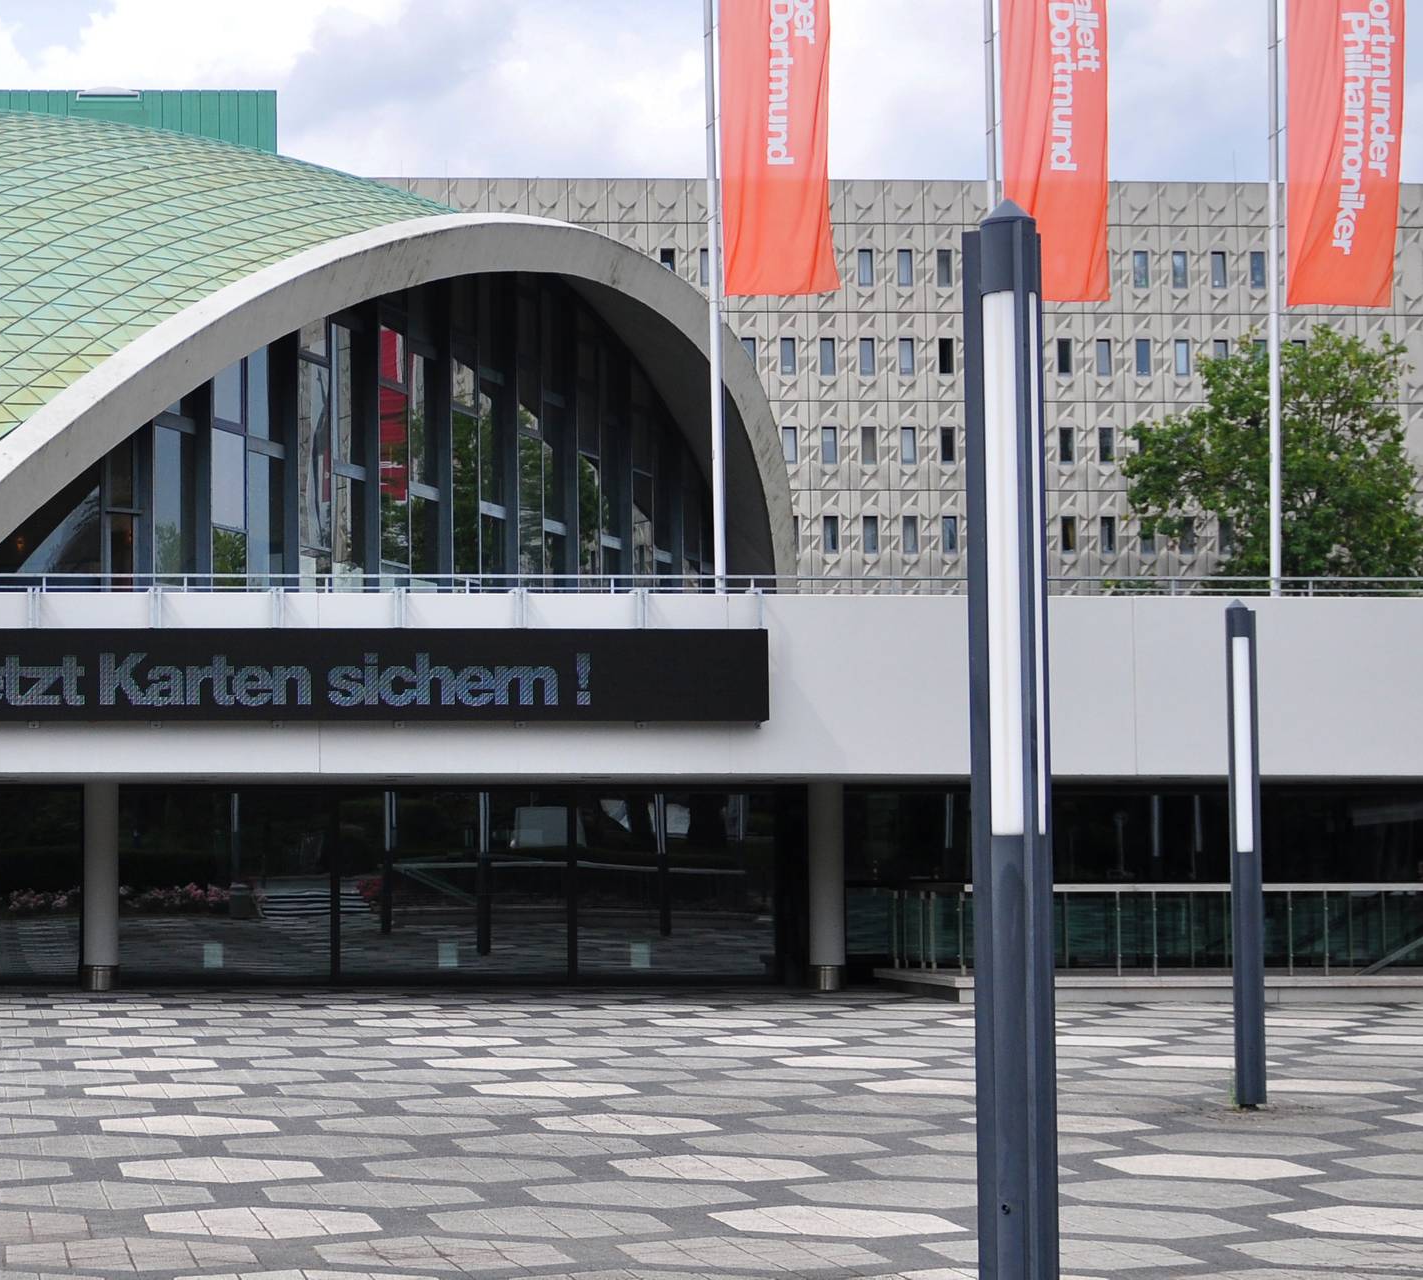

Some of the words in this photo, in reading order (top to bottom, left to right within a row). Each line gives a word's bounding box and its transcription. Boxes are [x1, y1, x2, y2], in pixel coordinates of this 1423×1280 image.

[767, 0, 794, 165] Dortmund
[1048, 2, 1078, 171] Dortmund
[1332, 12, 1371, 256] Philharmoniker
[1368, 0, 1395, 178] ortmunder
[99, 653, 312, 707] Karten
[328, 653, 559, 707] sichern
